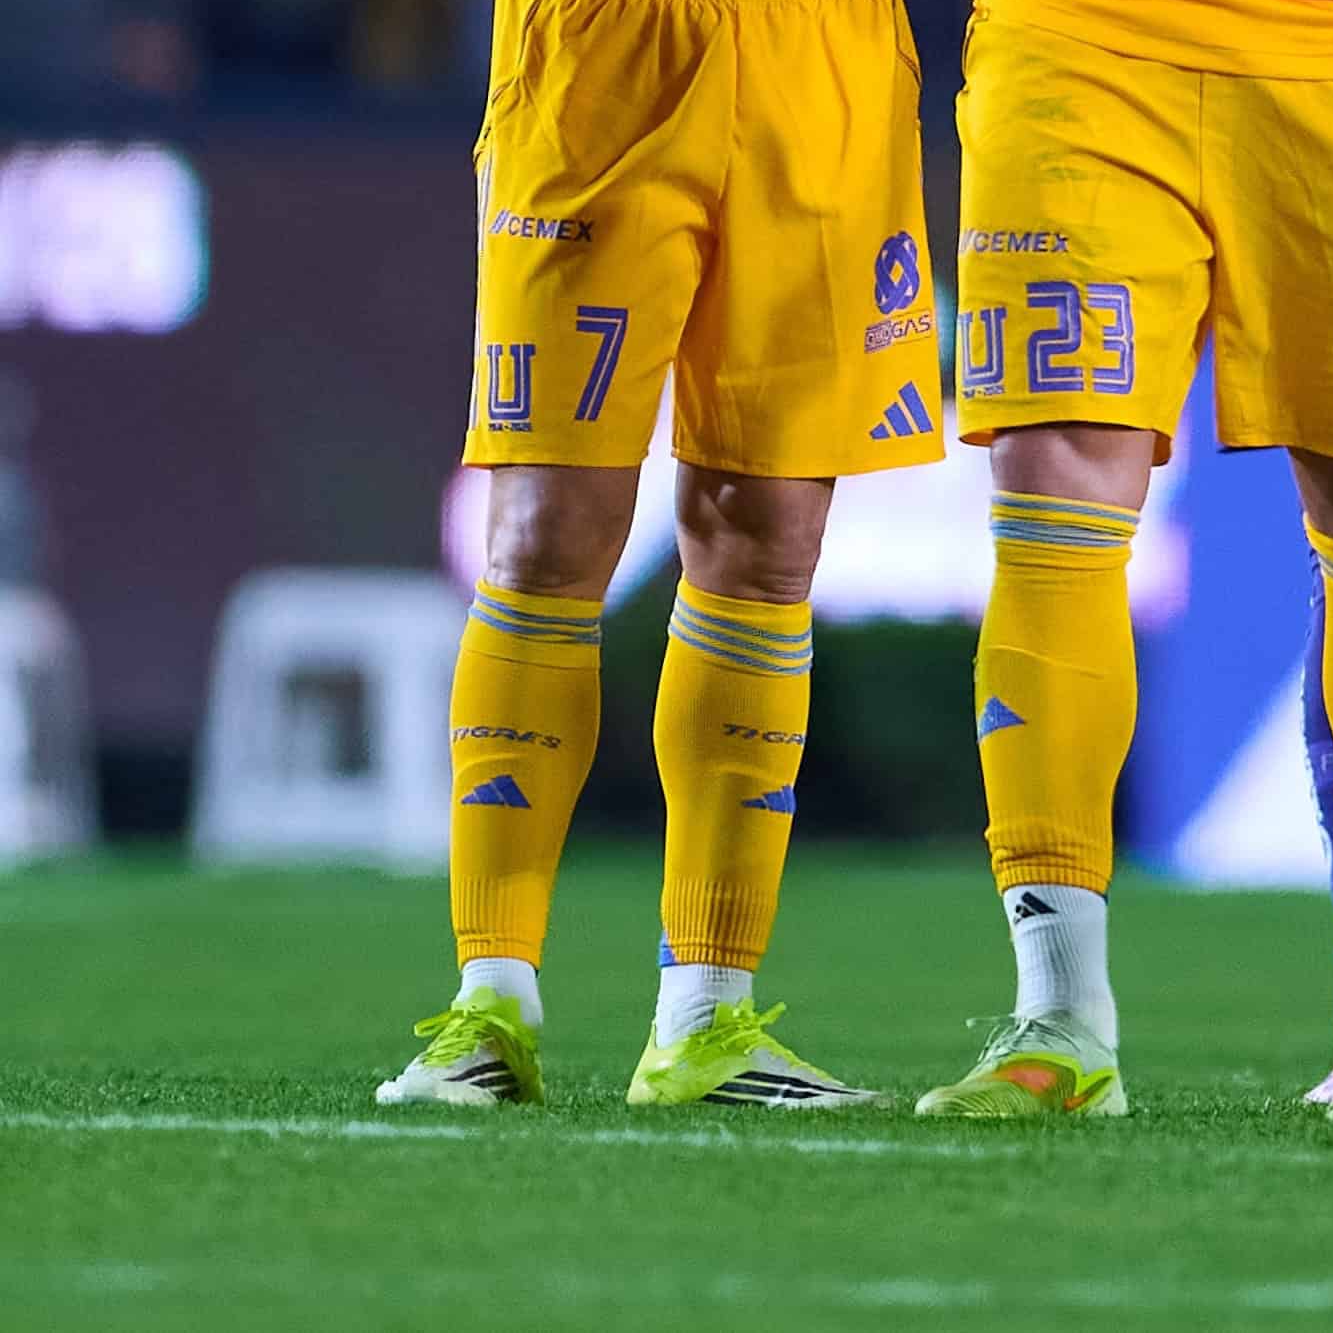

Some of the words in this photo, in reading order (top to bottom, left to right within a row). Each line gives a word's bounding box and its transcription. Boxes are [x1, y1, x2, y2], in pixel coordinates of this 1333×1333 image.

[508, 217, 594, 242] CEMEX
[974, 231, 1069, 253] CEMEX
[575, 305, 629, 422] 7
[1026, 281, 1135, 395] 23
